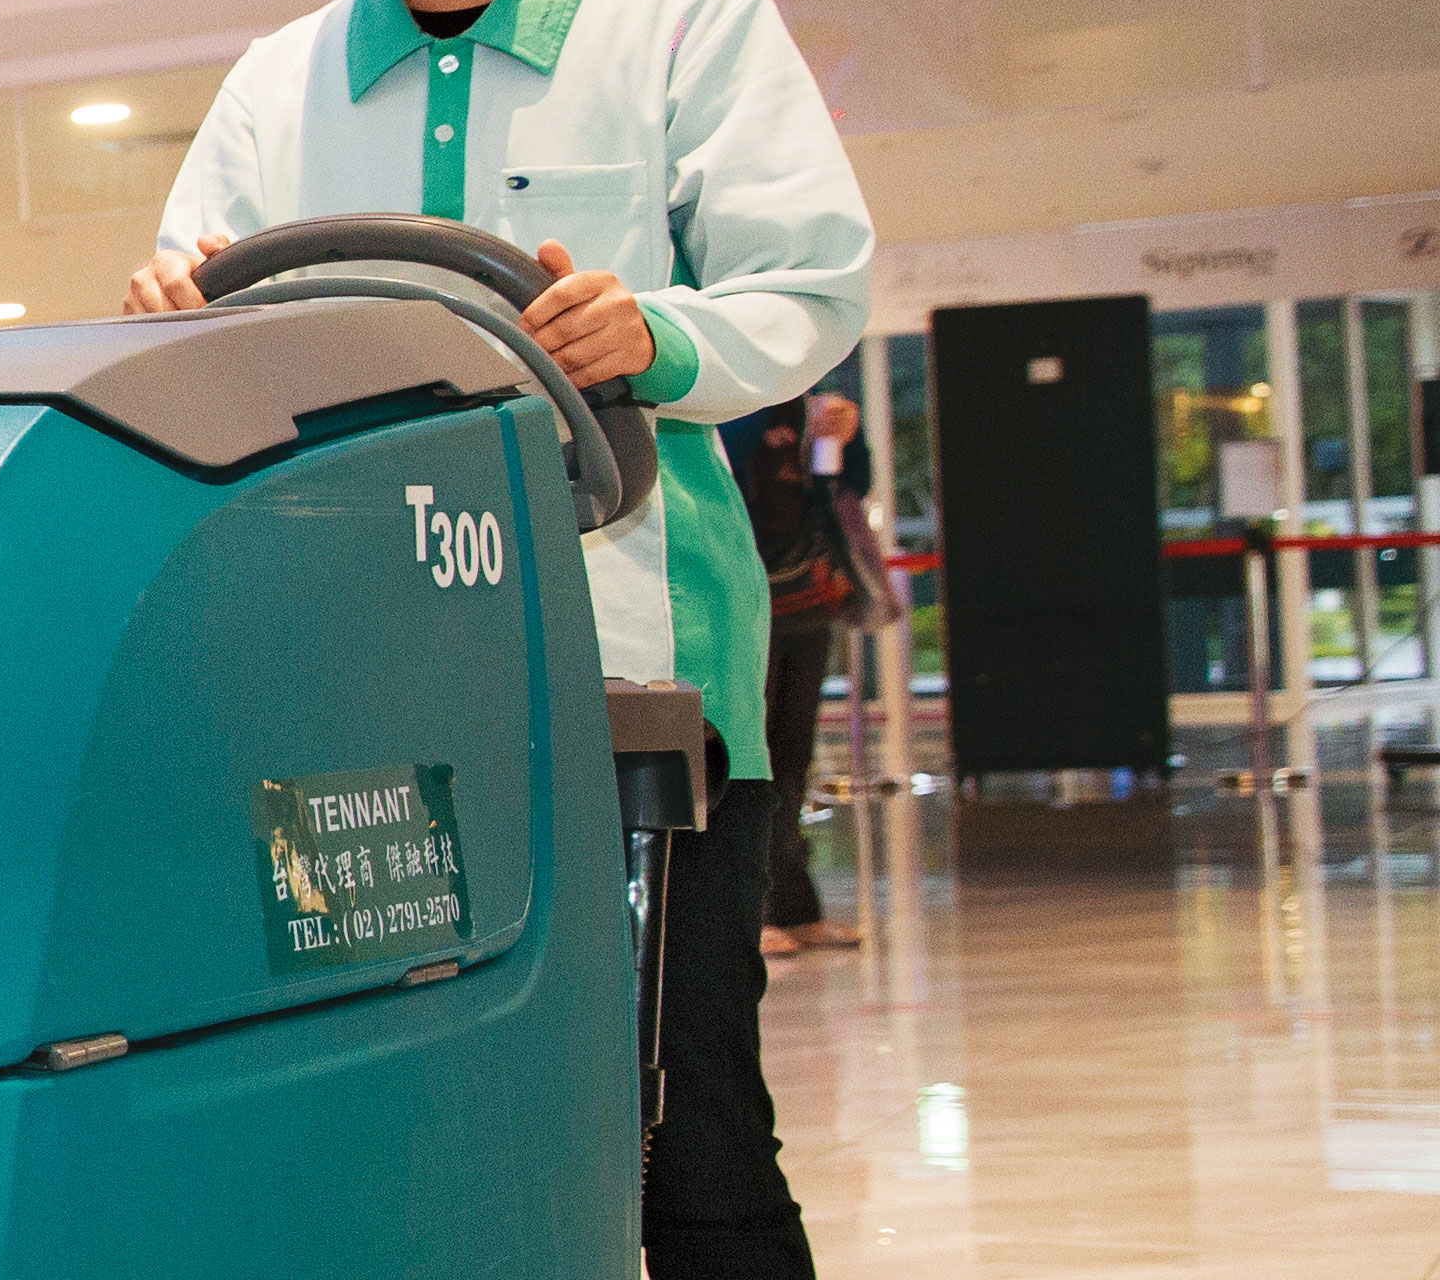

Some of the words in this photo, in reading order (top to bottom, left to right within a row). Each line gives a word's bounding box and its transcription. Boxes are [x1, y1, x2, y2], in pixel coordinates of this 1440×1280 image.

[405, 485, 504, 588] T300
[308, 785, 411, 834] TENNANT
[272, 844, 376, 902] 台灣代理商
